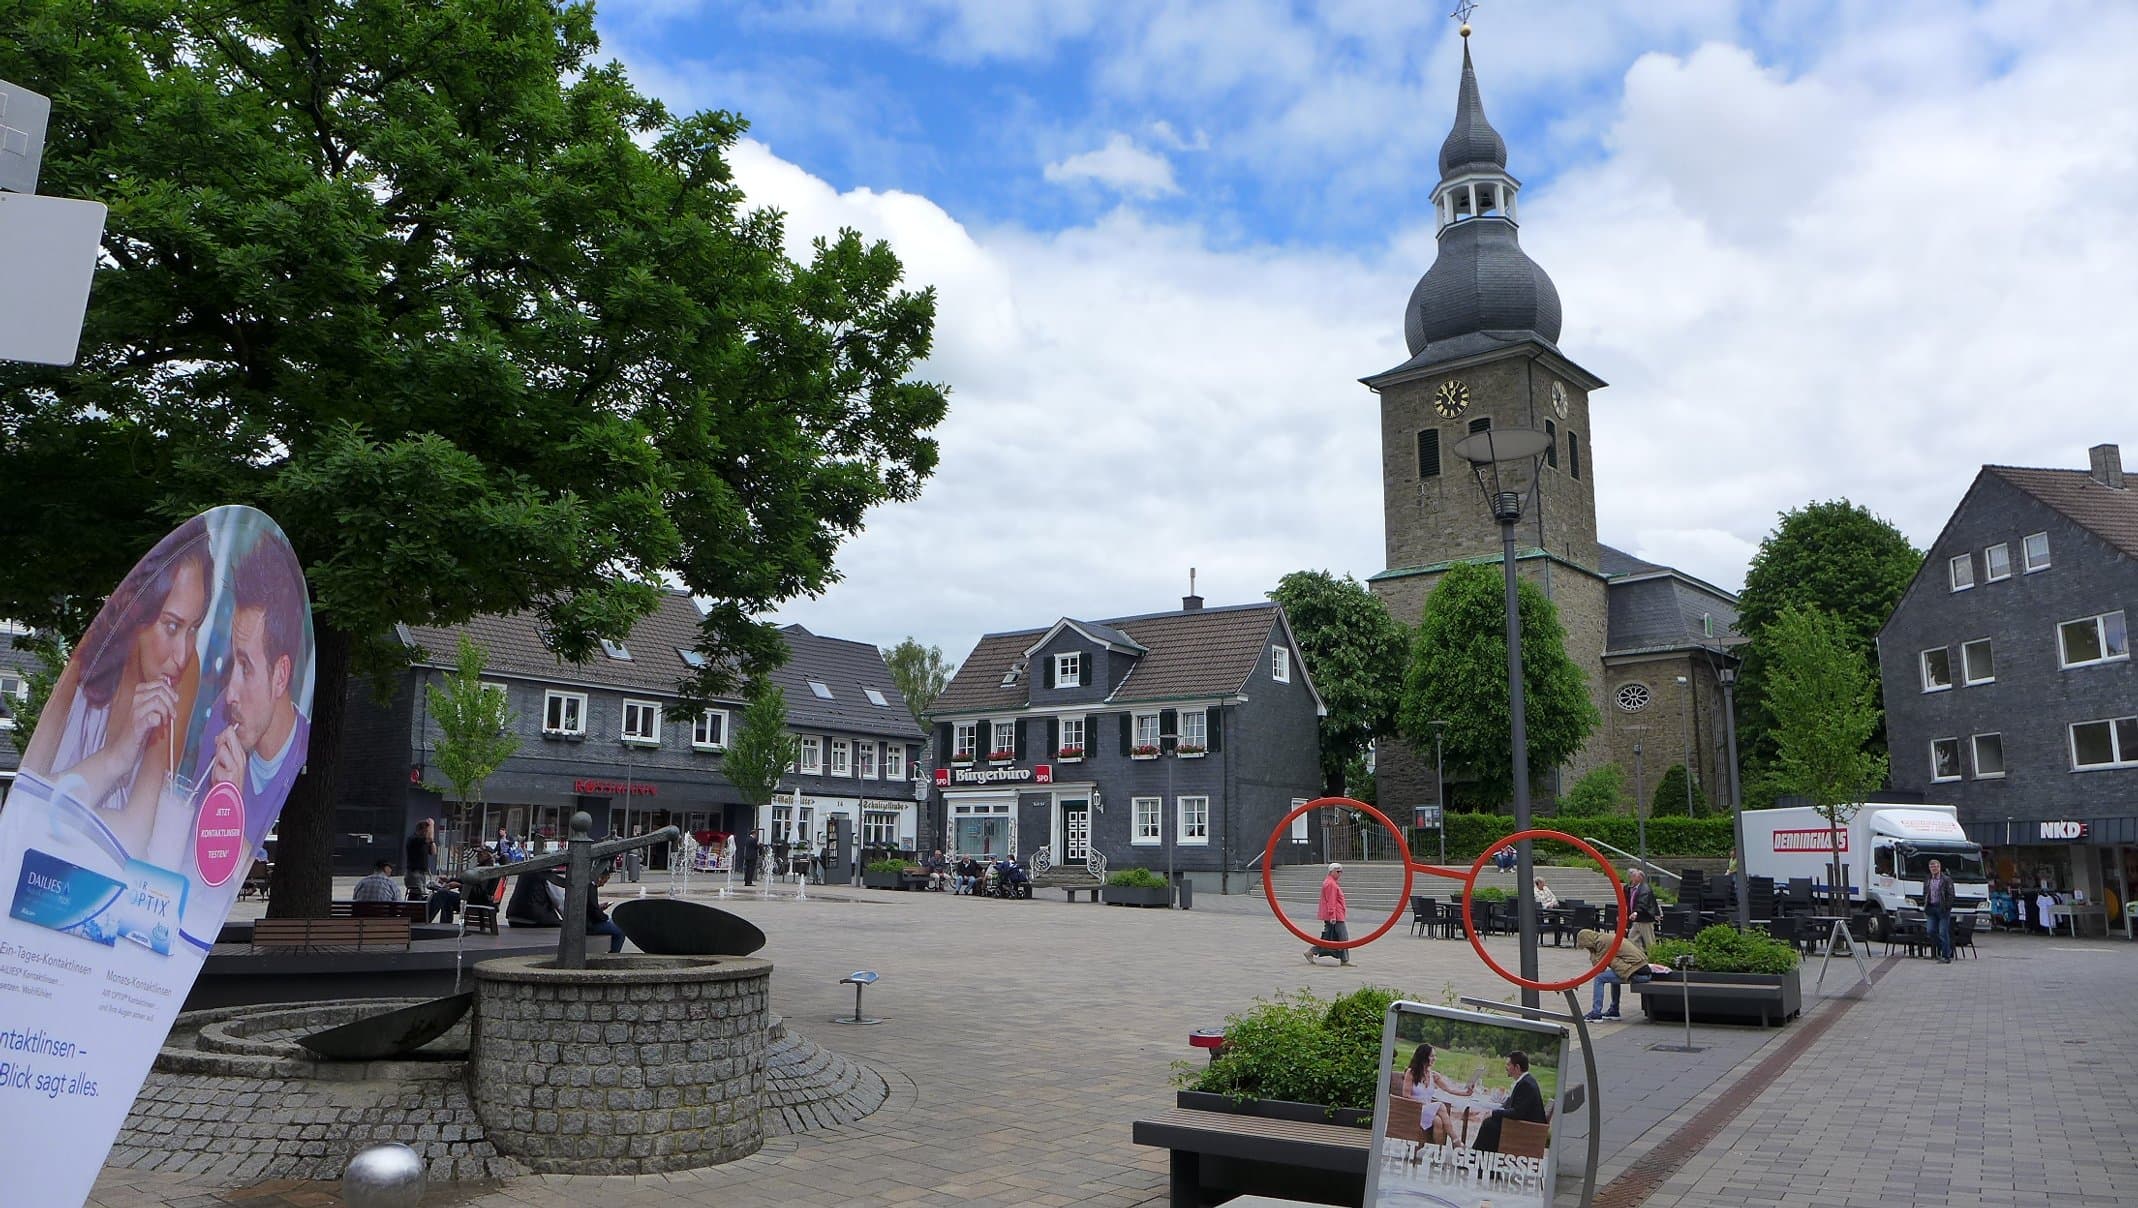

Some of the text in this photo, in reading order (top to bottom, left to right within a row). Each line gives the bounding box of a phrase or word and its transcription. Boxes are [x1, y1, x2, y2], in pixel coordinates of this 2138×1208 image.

[955, 766, 1031, 784] Bürgerbüro
[2040, 820, 2081, 839] NKD
[28, 871, 62, 894] DAILIES
[0, 1062, 99, 1099] Blick sagt alles.
